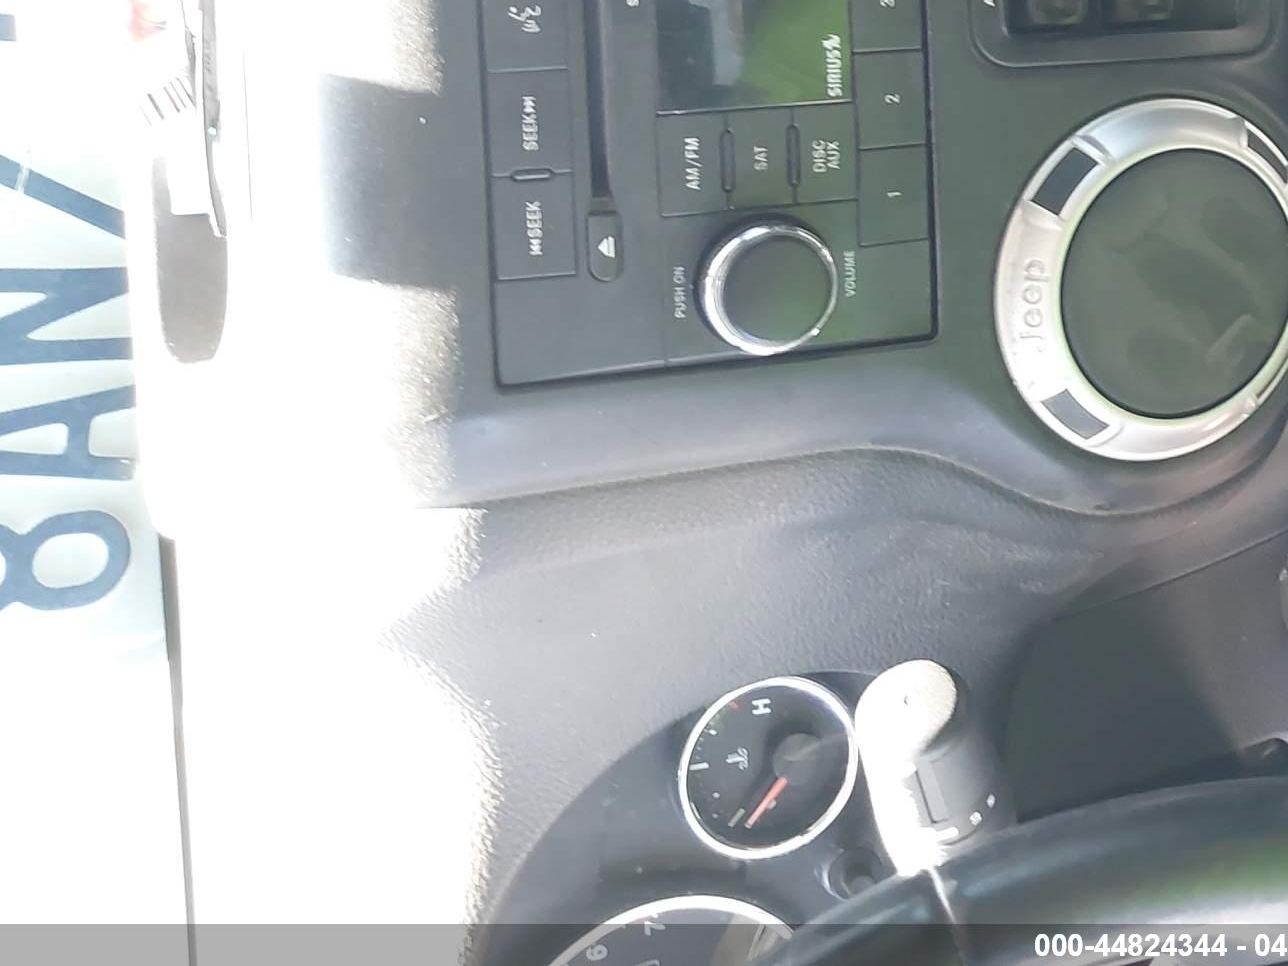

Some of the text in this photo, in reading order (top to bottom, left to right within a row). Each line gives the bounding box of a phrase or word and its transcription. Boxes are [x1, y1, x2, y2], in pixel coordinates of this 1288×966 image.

[826, 48, 843, 96] SIRIUS
[885, 94, 899, 103] 2
[522, 115, 539, 151] SEEK
[685, 138, 701, 189] AM/FM
[754, 147, 767, 170] SAT
[813, 140, 826, 172] DISC
[827, 142, 840, 169] AUX
[526, 201, 543, 238] SEEK
[844, 251, 856, 296] VOLUME
[673, 267, 686, 318] PUSH ON
[1020, 258, 1049, 353] Jeep
[752, 699, 771, 715] H
[644, 920, 666, 936] 7
[586, 943, 609, 961] 6
